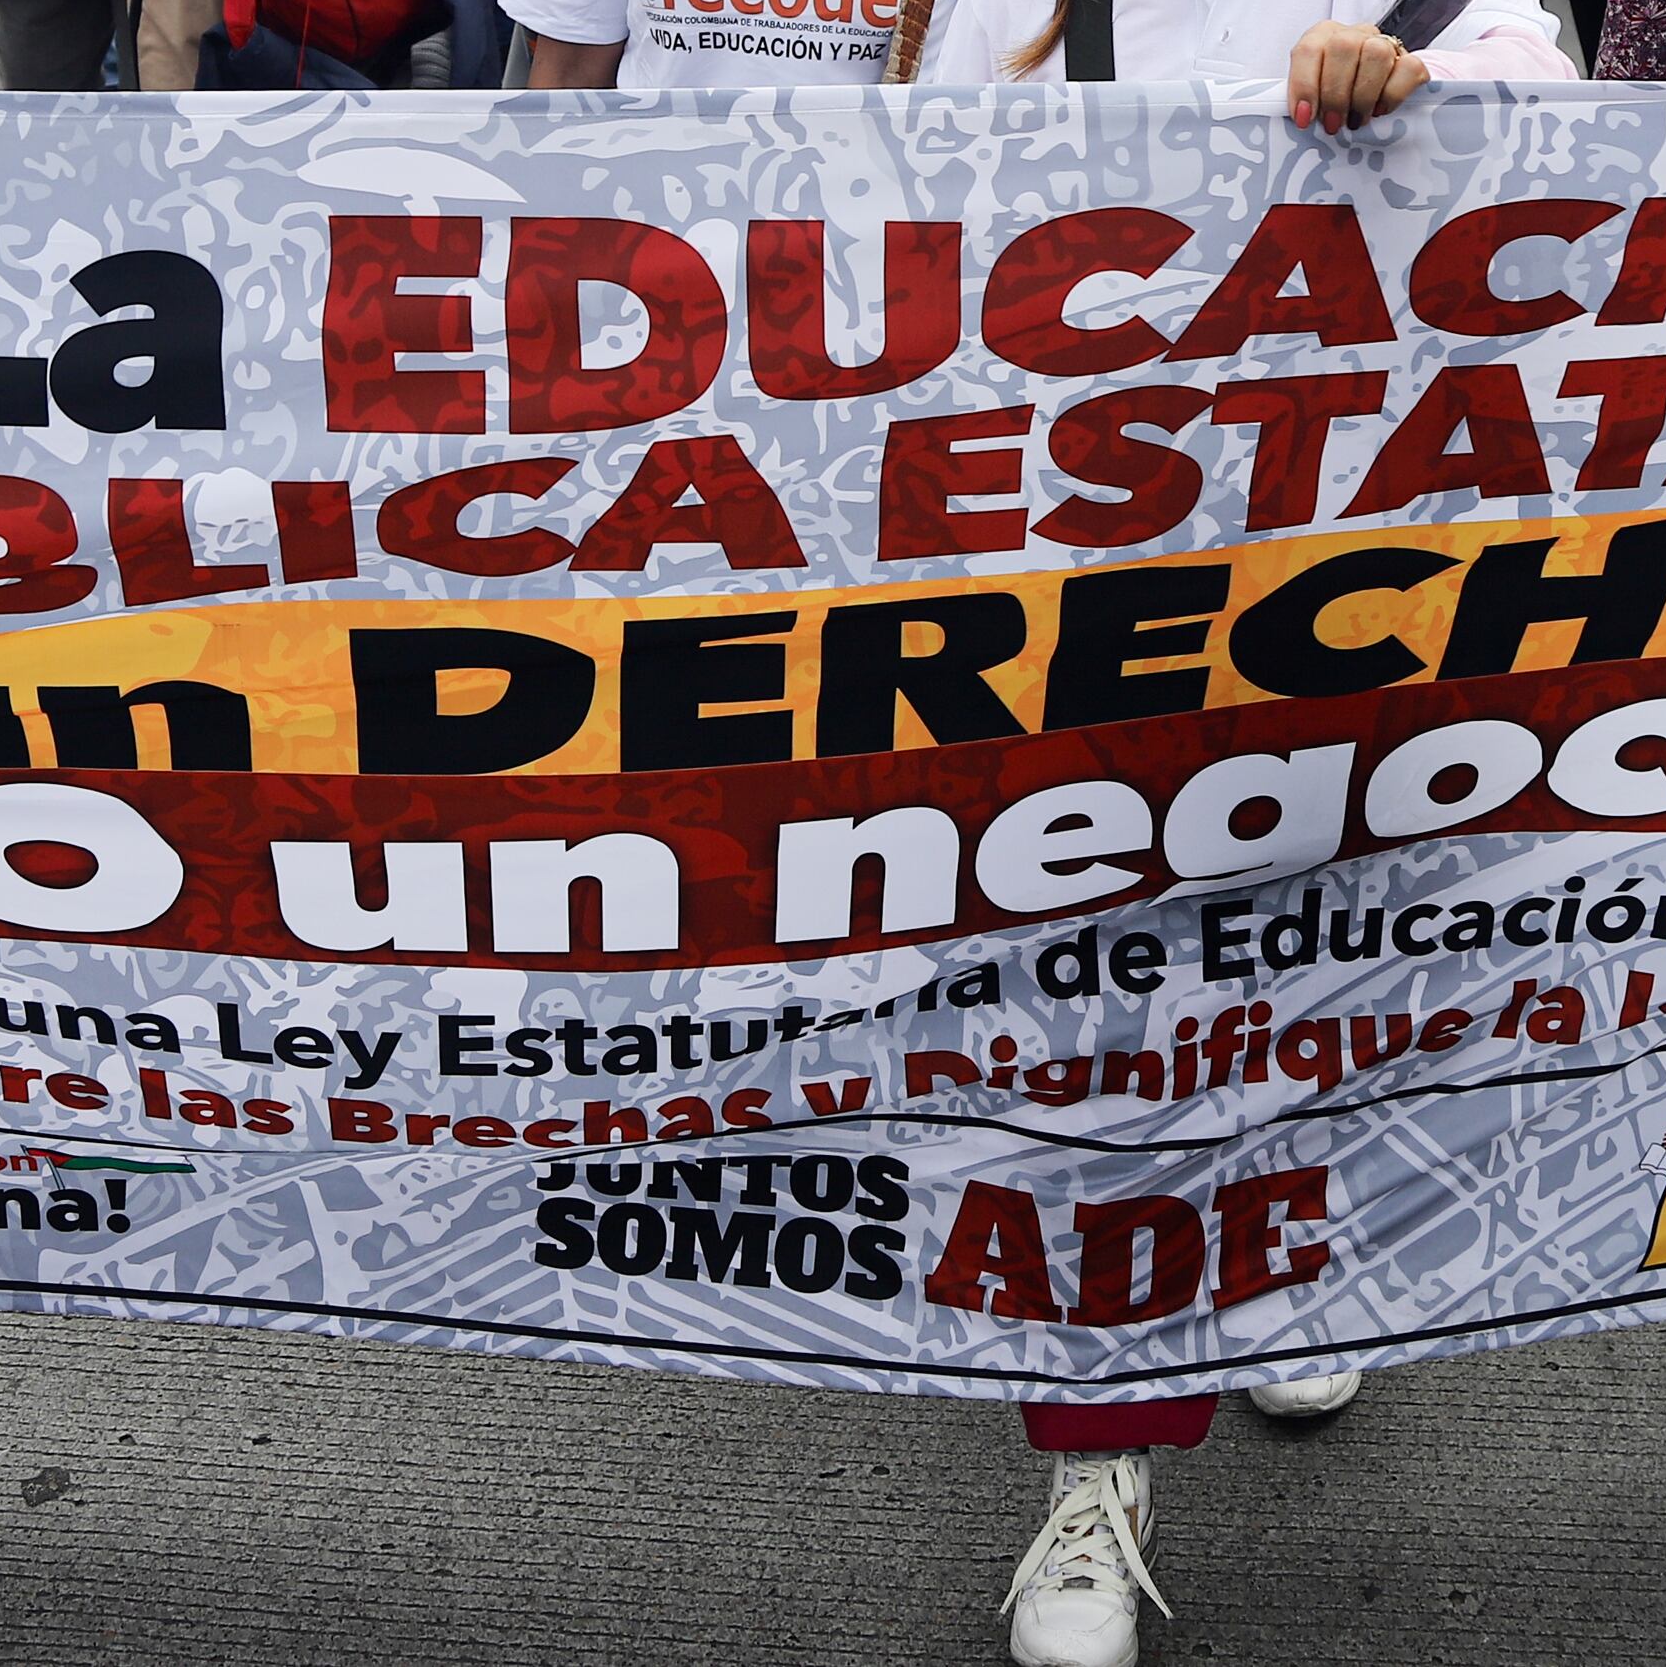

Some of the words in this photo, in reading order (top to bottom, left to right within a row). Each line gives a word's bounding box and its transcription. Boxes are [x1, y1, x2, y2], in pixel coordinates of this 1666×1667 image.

[650, 27, 692, 54] VIDA,
[698, 30, 823, 61] EDUCACIÓN
[829, 42, 844, 61] Y
[847, 42, 887, 62] PAZ
[684, 15, 739, 26] COLOMBIANA
[740, 17, 752, 27] DE
[754, 19, 820, 33] TRABAJADORES
[822, 24, 834, 34] DE
[835, 26, 846, 35] LA
[269, 832, 680, 955] un
[139, 1066, 296, 1136] las
[328, 1086, 774, 1150] Brechas
[1490, 977, 1586, 1045] la
[215, 1001, 404, 1091] Ley
[1033, 920, 1168, 1000] de
[533, 1196, 907, 1302] SOMOS
[923, 1164, 1331, 1329] ADE
